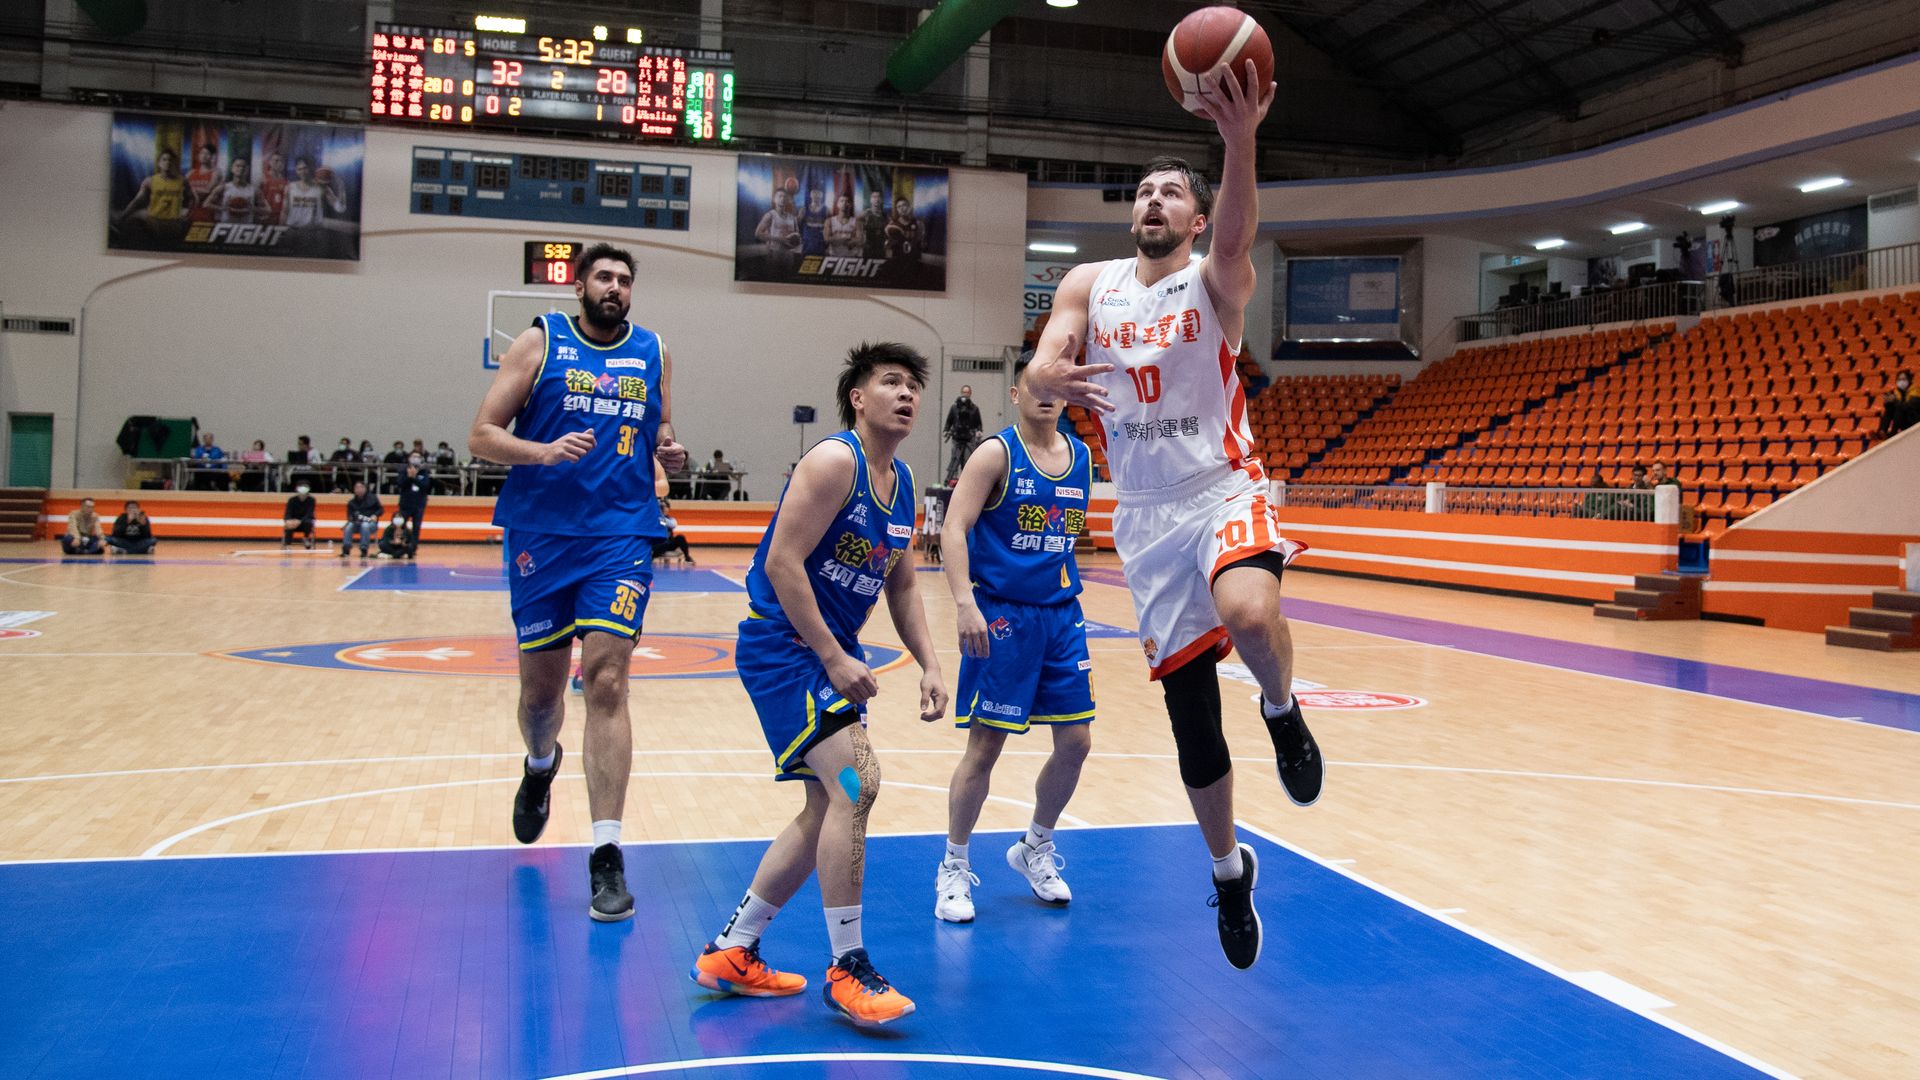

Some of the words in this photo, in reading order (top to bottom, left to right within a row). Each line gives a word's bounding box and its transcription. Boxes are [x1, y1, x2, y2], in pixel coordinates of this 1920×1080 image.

[483, 38, 517, 51] HOME
[538, 36, 594, 65] 5:32
[599, 47, 633, 60] GUEST
[491, 60, 523, 87] 32
[551, 70, 565, 90] 2
[596, 68, 628, 95] 28
[462, 80, 474, 96] 0
[532, 90, 559, 100] PLAYER
[561, 92, 580, 102] FOUL
[461, 106, 473, 122] 0
[486, 95, 499, 114] 0
[508, 96, 522, 116] 2
[596, 104, 603, 121] 1
[621, 105, 635, 124] 0
[209, 223, 288, 245] FIGHT
[544, 243, 572, 259] 5:32
[547, 261, 567, 283] 18
[818, 257, 886, 277] FIGHT
[565, 368, 597, 394] 裕
[618, 375, 647, 402] 隆
[1125, 364, 1160, 404] 10
[1017, 504, 1047, 532] 裕
[835, 531, 872, 568] 裕
[610, 585, 640, 622] 35
